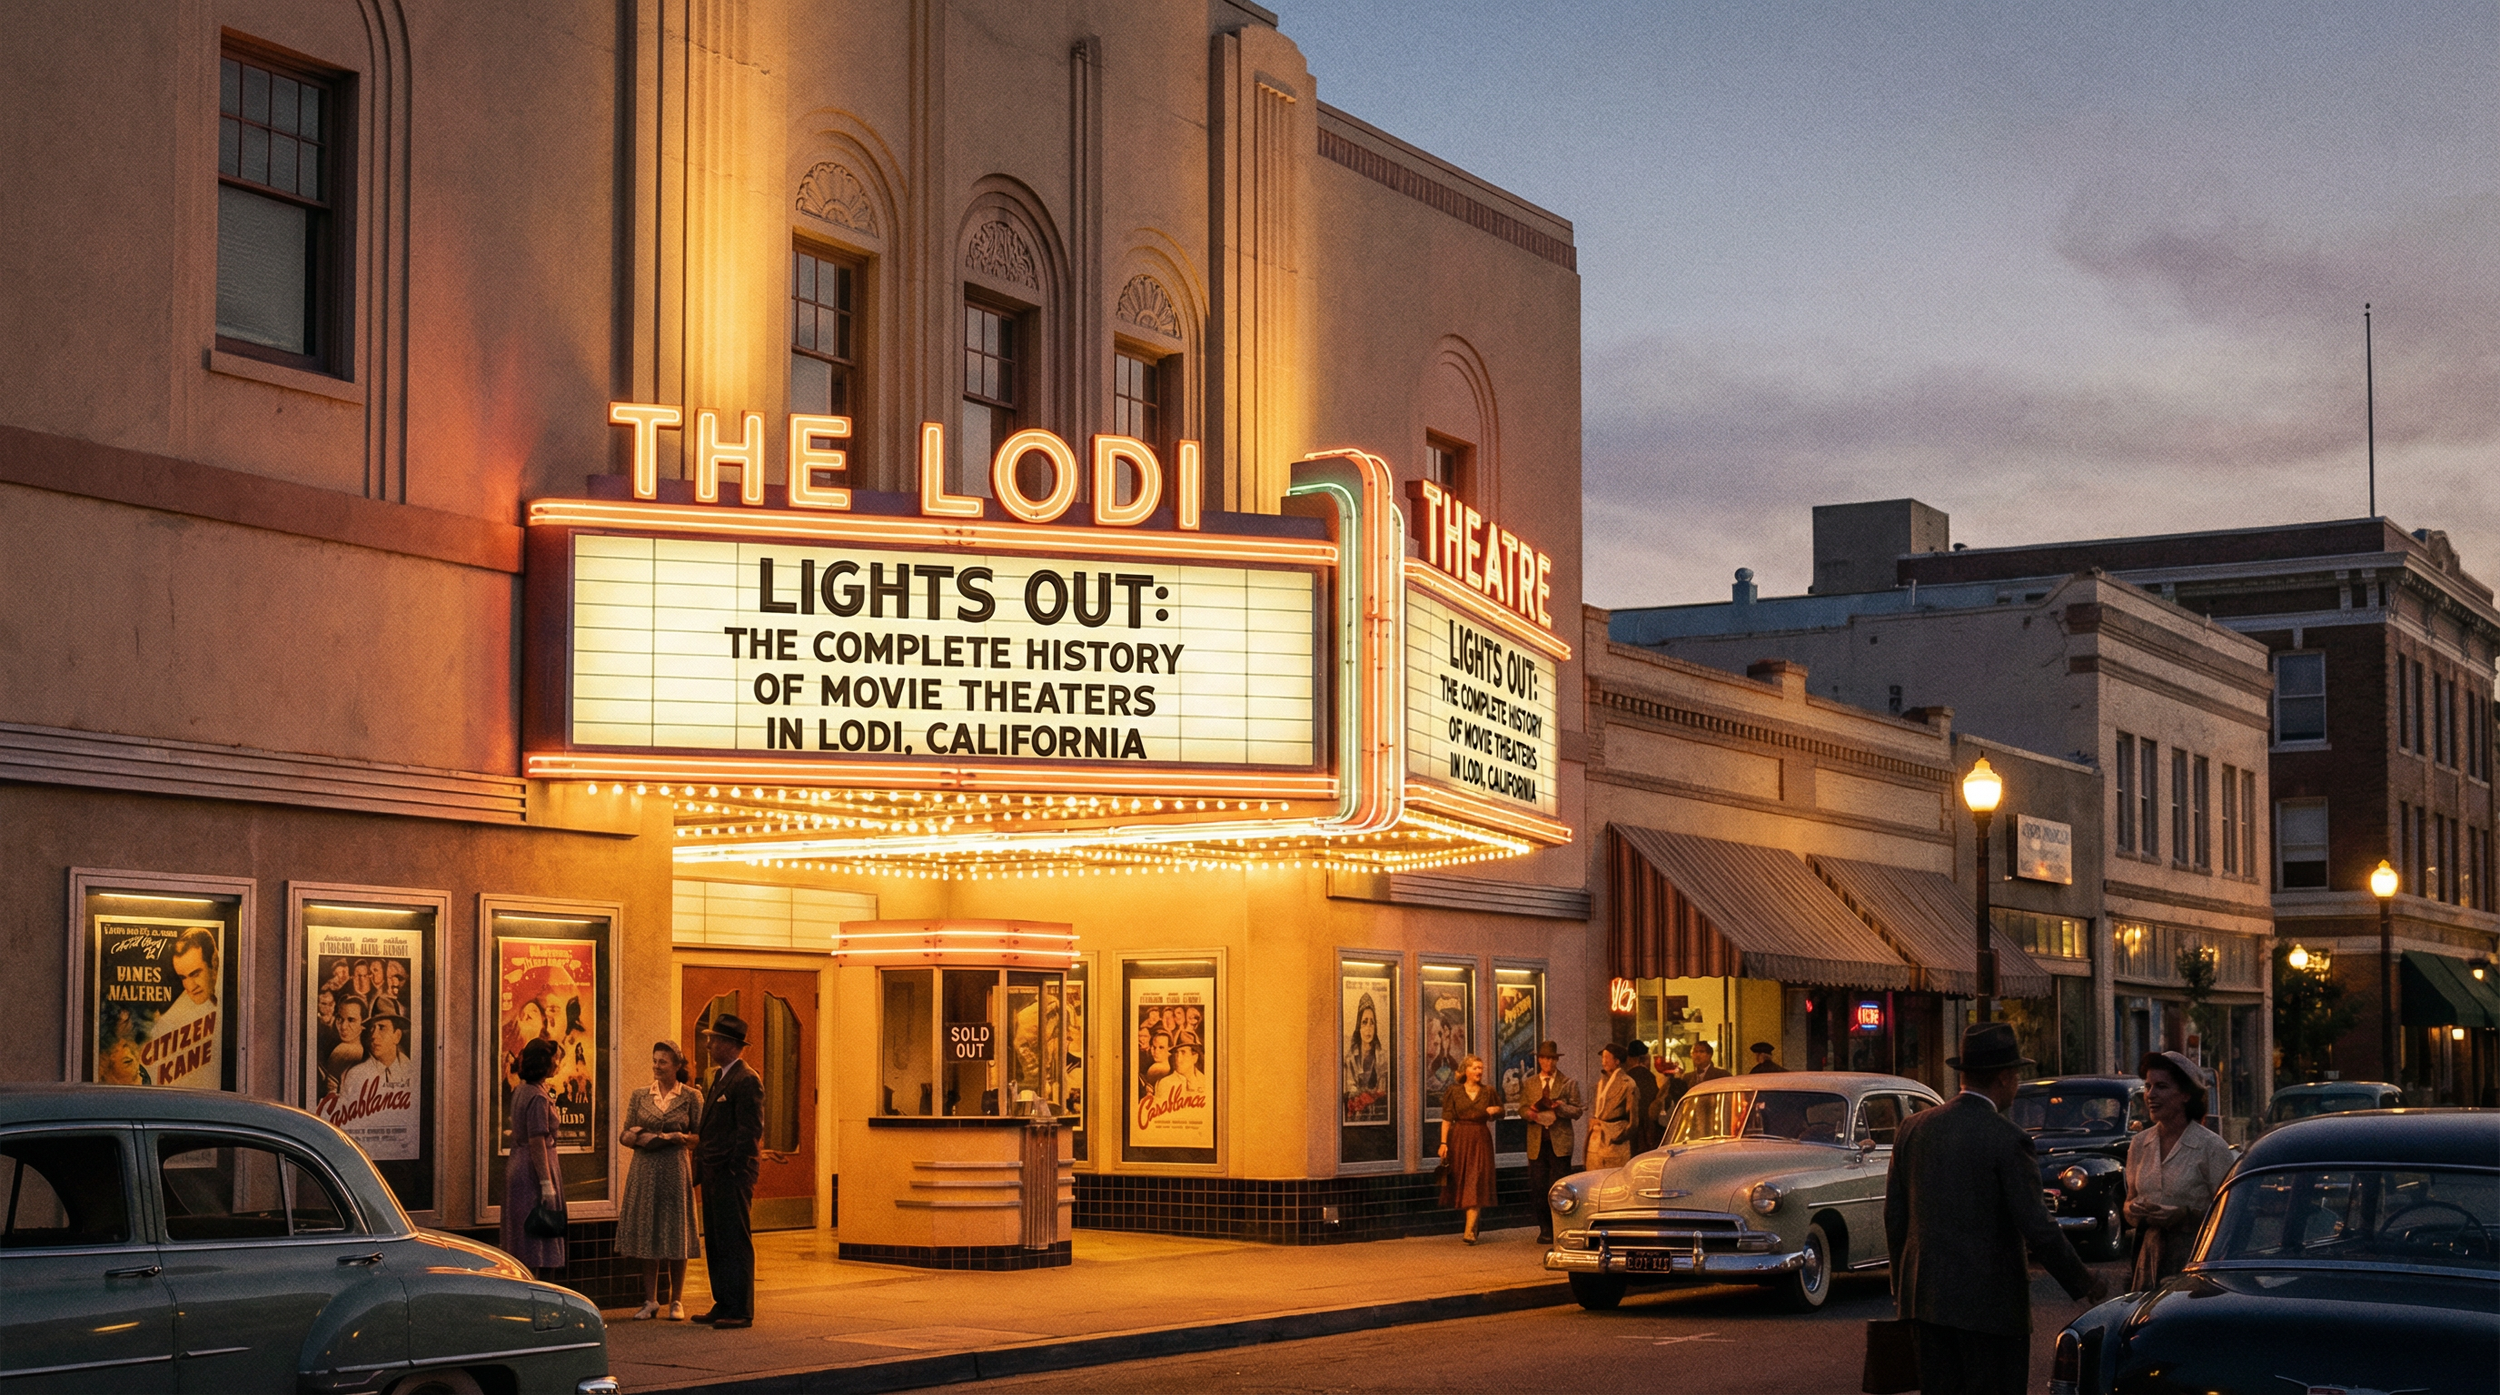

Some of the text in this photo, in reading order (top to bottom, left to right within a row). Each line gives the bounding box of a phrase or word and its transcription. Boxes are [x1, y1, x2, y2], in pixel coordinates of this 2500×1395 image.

[609, 402, 1201, 531] THE LODI
[1422, 479, 1552, 630] THEATRE
[759, 557, 1170, 630] LIGHTS OUT:
[724, 626, 1185, 675] THE COMPLETE HISTORY
[1448, 618, 1538, 702] LIGHTS OUT:
[753, 672, 1156, 718] OF MOVIE THEATERS
[1440, 673, 1543, 740] THE COMPLETE HISTORY
[766, 717, 1148, 760] IN LODI, CALIFORNIA
[1449, 715, 1538, 771] OF MOVIE THEATERS
[1450, 752, 1537, 805] IN LODI, CALIFORNIA
[141, 1011, 217, 1066] CITIZEN
[951, 1026, 990, 1042] SOLD
[956, 1043, 985, 1058] OUT
[158, 1039, 213, 1085] KANE
[315, 1075, 411, 1128] Casablanca
